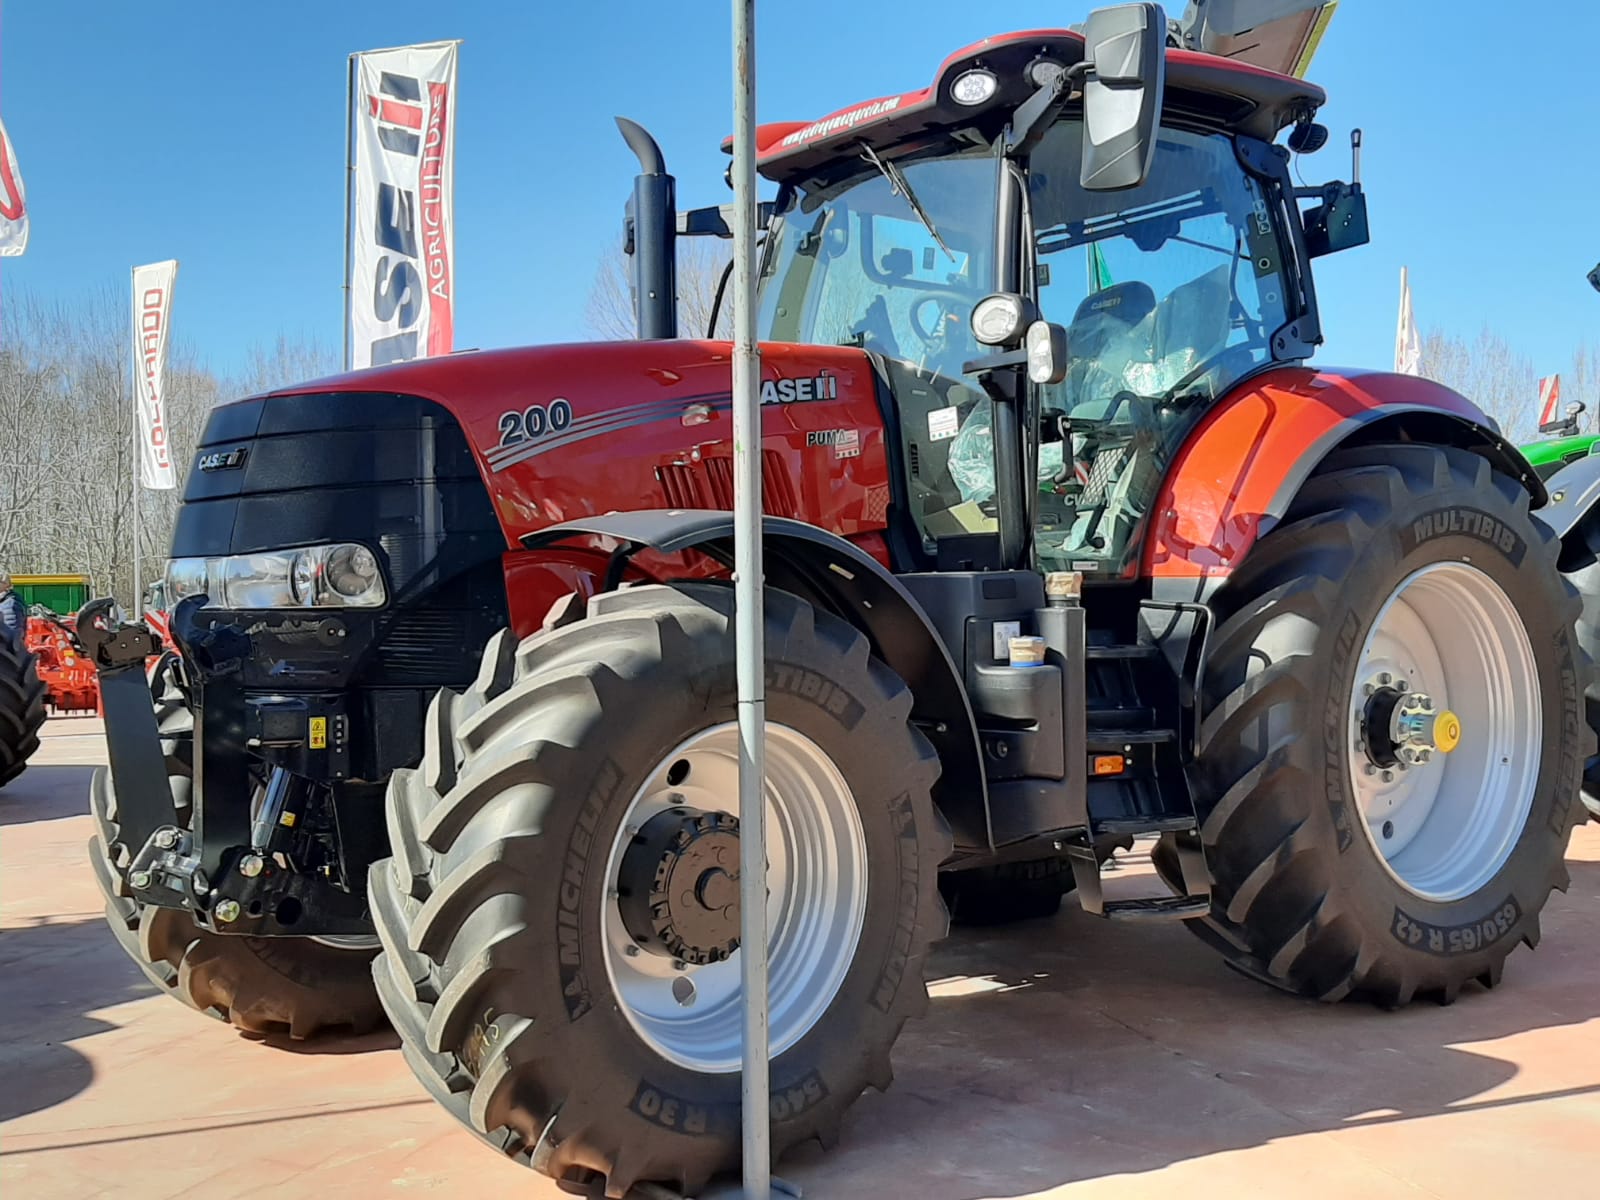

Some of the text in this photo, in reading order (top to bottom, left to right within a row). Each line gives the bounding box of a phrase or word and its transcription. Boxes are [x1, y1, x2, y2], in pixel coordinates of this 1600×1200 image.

[423, 94, 449, 299] AGRICULTURE
[370, 183, 424, 366] ASE
[760, 378, 812, 404] ASE
[496, 399, 573, 448] 200
[807, 428, 847, 447] PUMA
[198, 453, 226, 470] CASE
[1413, 510, 1516, 553] MULTIBIB
[768, 665, 850, 716] TIBIB
[1324, 612, 1360, 802] MICHELIN
[559, 760, 620, 965] MICHELIN
[1396, 903, 1516, 953] 650/65 R 42
[638, 1076, 822, 1133] 540 R 30
